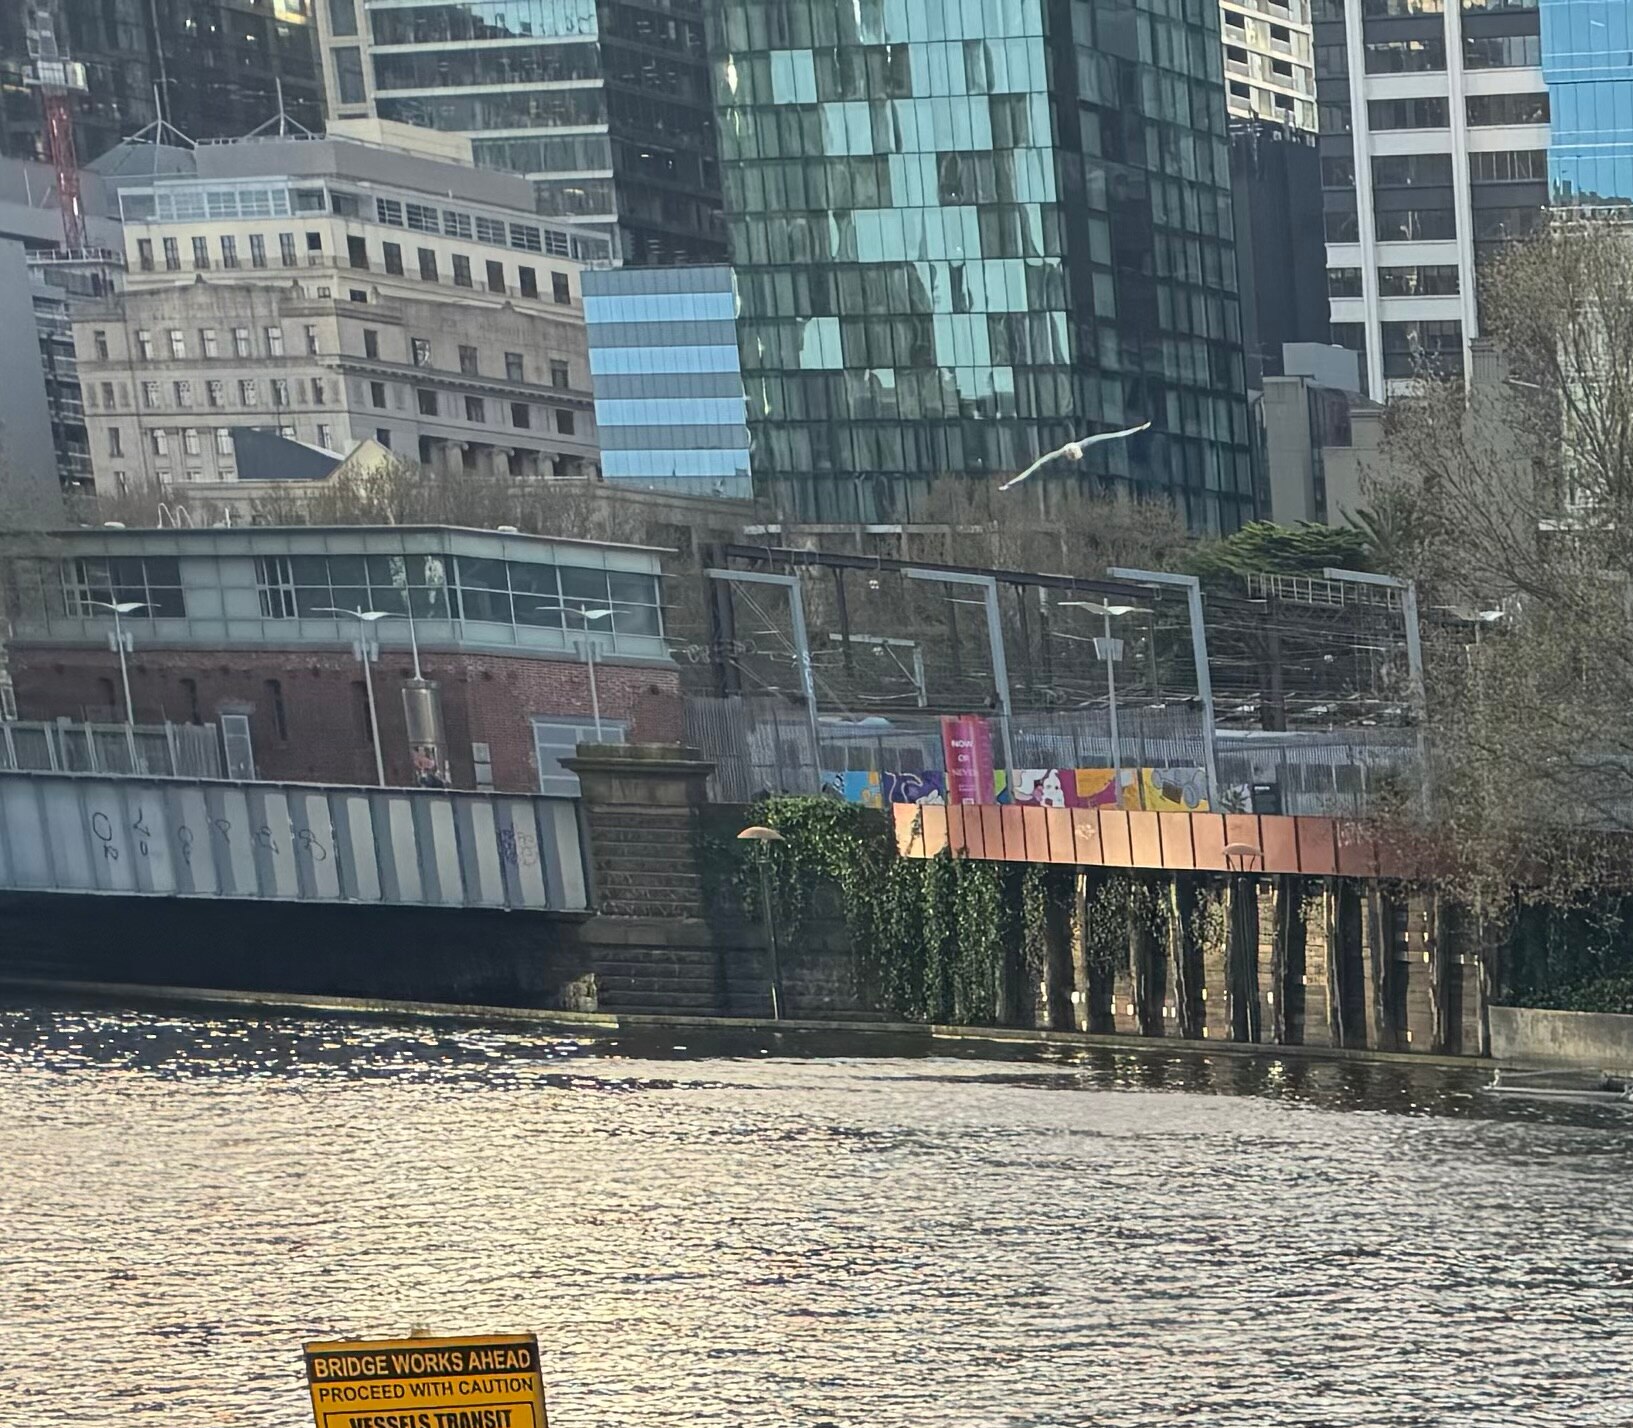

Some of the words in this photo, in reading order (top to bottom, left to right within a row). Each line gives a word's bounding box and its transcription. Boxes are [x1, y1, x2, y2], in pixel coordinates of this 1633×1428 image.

[314, 1355, 389, 1377] BRIDGE
[391, 1352, 463, 1374] WORKS
[469, 1349, 530, 1371] AHEAD
[319, 1384, 405, 1402] PROCEED
[409, 1381, 453, 1397] WITH
[459, 1377, 533, 1395] CAUTION
